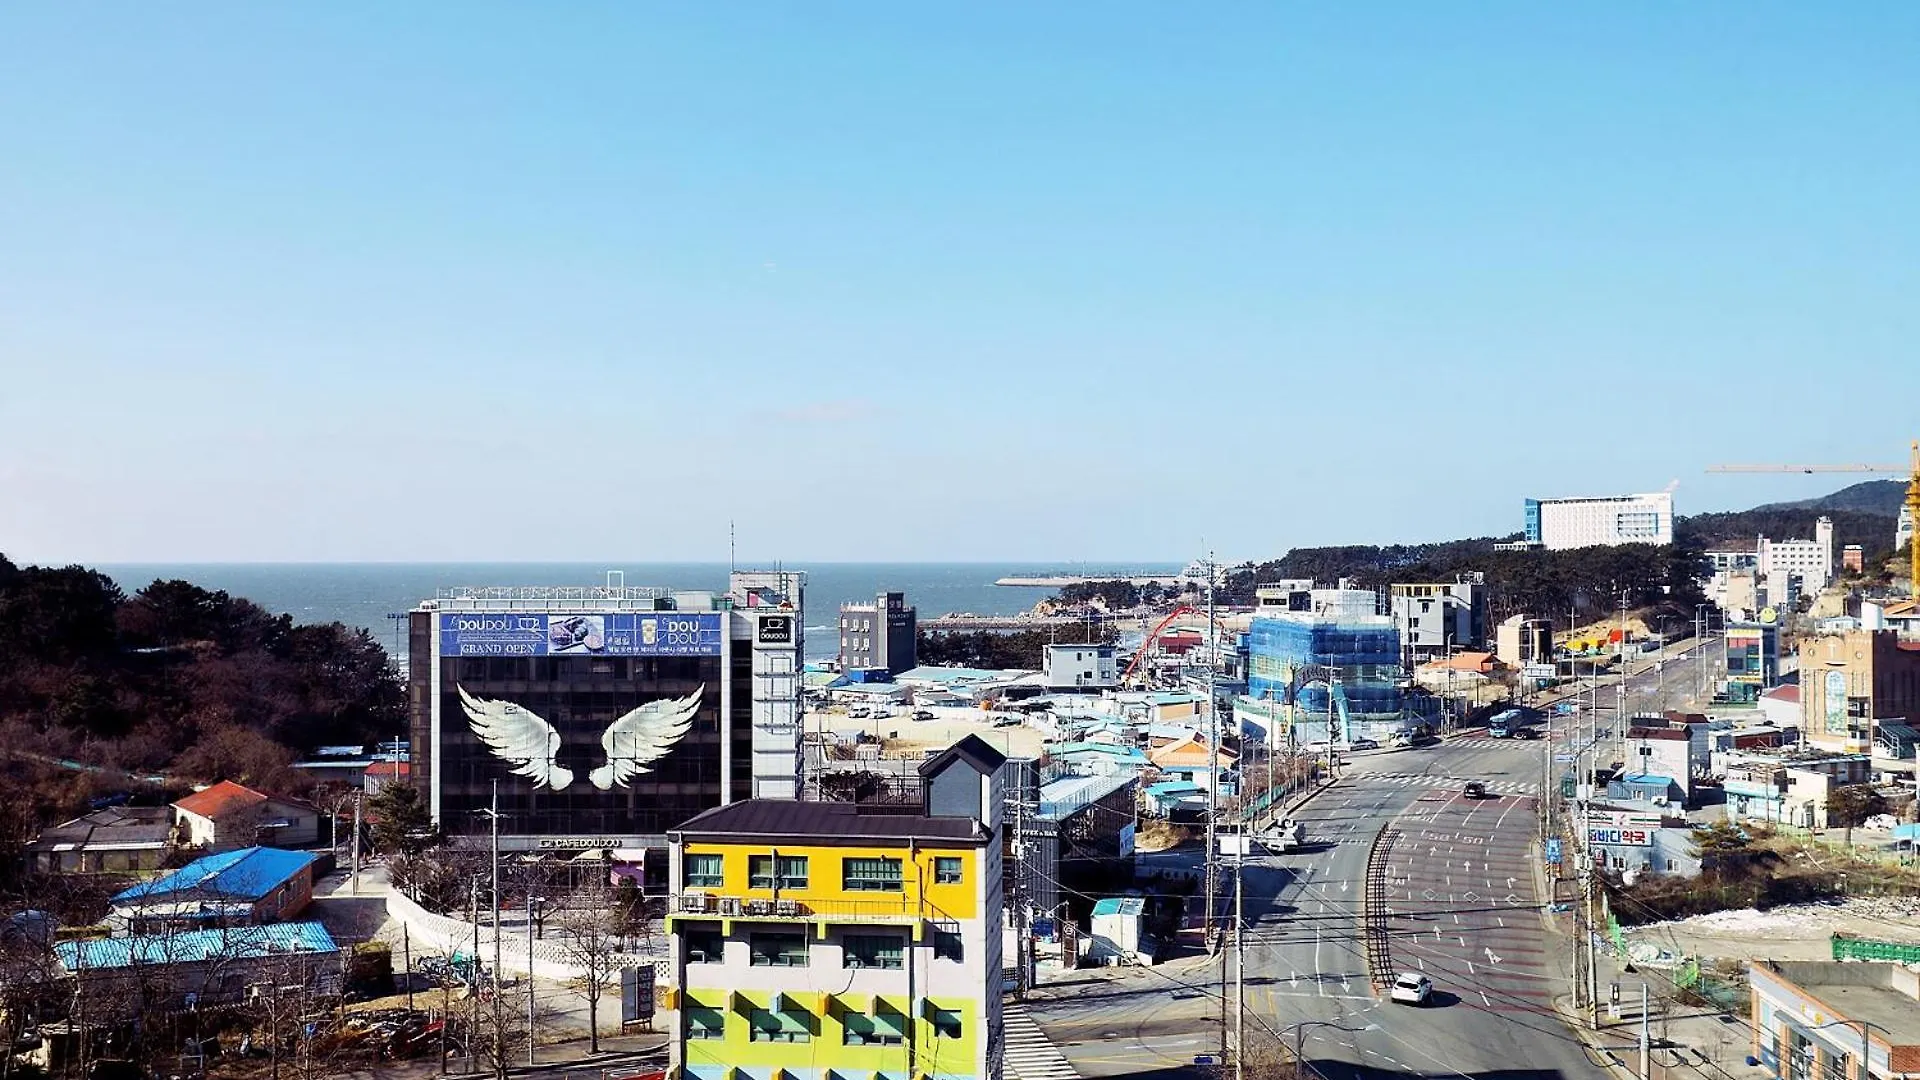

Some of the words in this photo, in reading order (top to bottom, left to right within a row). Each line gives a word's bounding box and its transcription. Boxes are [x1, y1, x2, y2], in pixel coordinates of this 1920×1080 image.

[458, 620, 513, 631] DOUDOU
[668, 621, 699, 632] DOU
[668, 633, 699, 645] DOU
[462, 644, 502, 654] GRAND
[506, 643, 537, 654] OPEN
